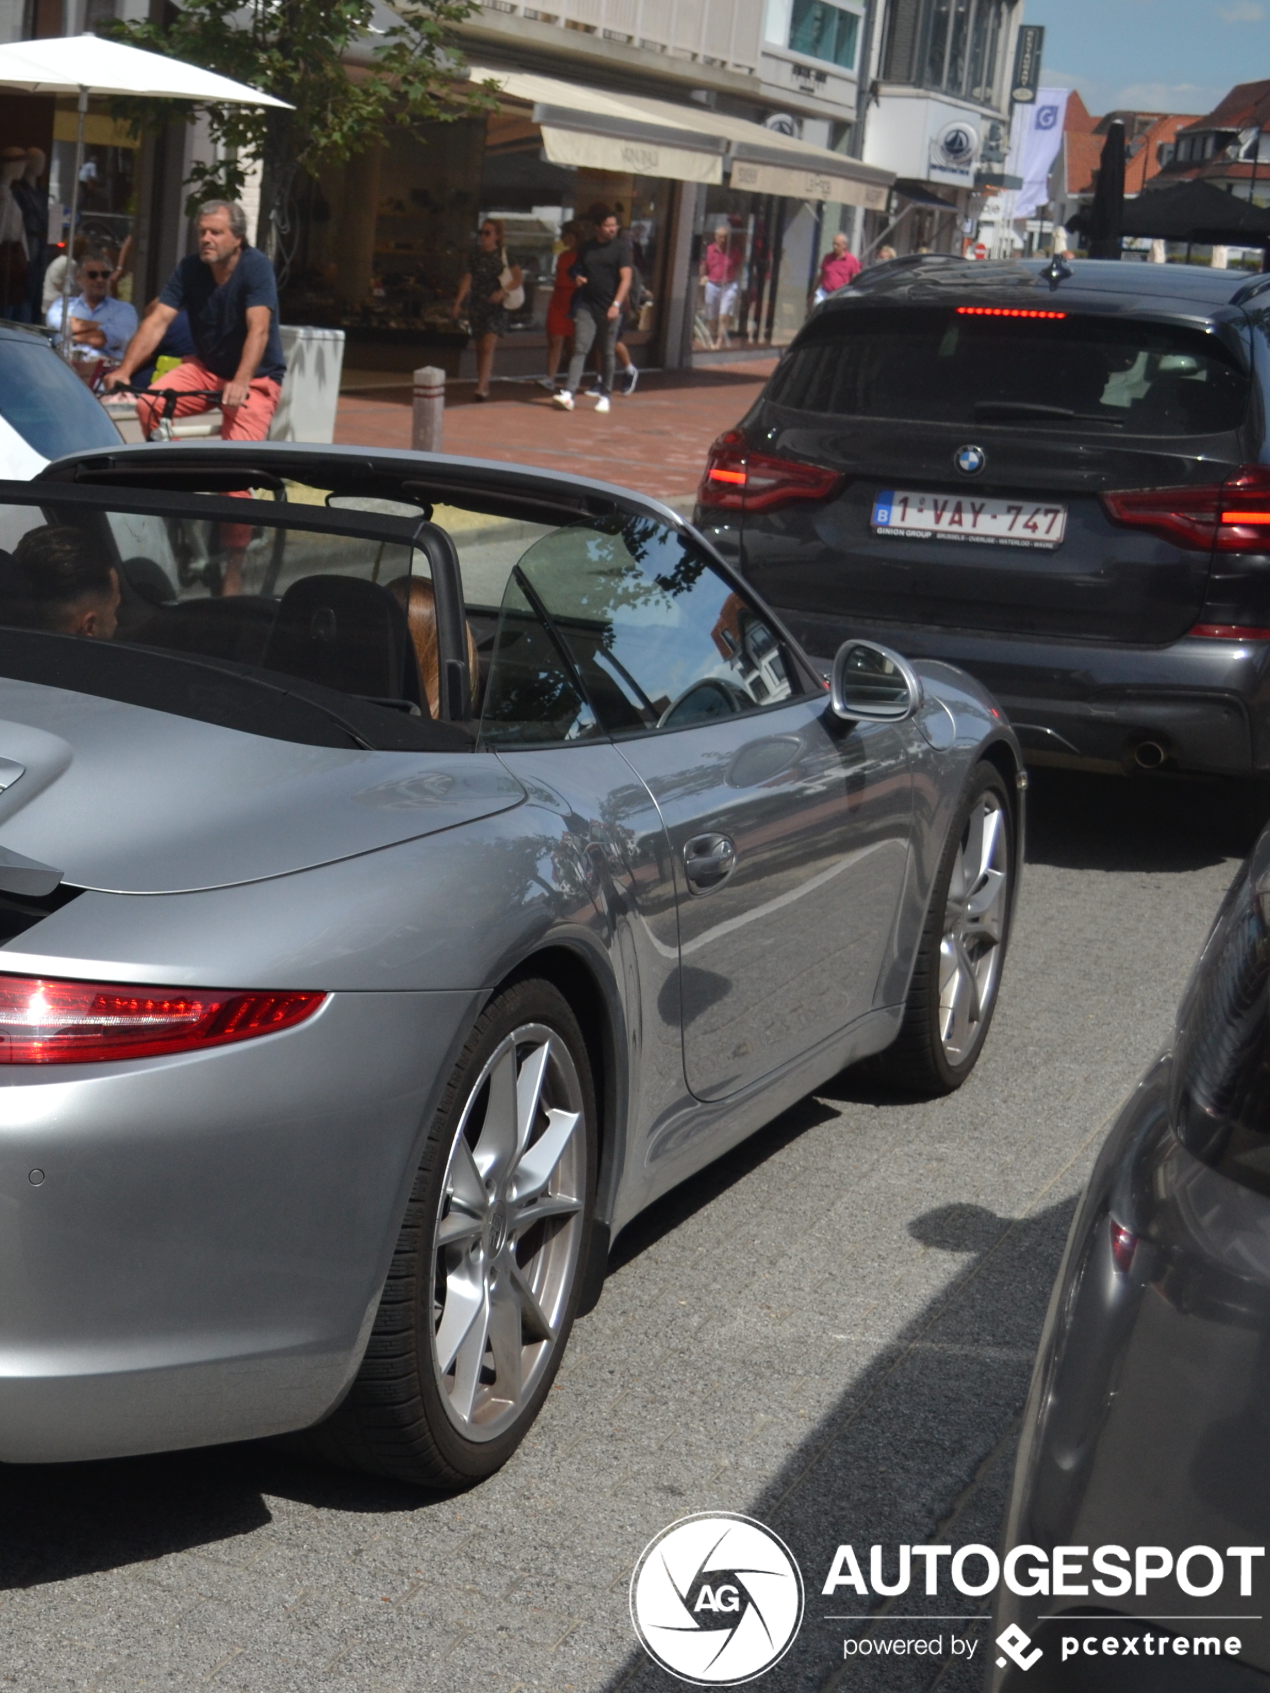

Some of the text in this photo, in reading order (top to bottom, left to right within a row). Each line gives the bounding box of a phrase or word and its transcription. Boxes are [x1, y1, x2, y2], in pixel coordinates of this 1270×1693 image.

[877, 509, 888, 523] B
[877, 526, 932, 540] GINION GROUP
